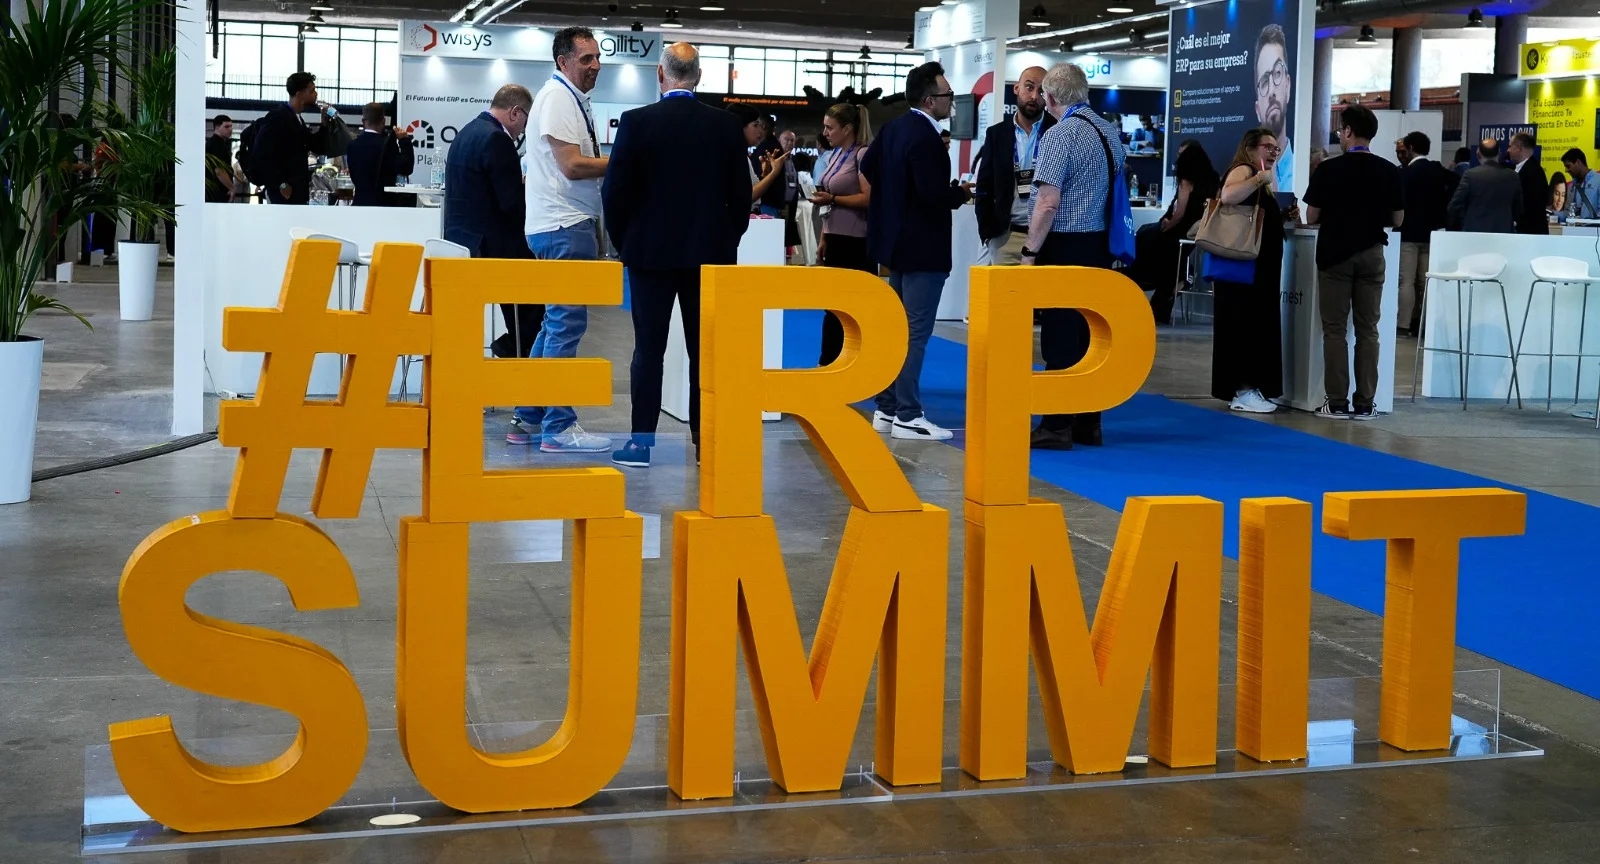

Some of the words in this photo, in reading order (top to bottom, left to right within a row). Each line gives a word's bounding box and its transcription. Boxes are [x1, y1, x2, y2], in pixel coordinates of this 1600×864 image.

[441, 32, 492, 51] wisys
[600, 34, 655, 58] gility
[1175, 34, 1194, 54] ¿Cuál
[1195, 37, 1202, 48] es
[1203, 32, 1209, 47] el
[1210, 30, 1231, 49] mejor
[1175, 58, 1189, 73] ERP
[1189, 60, 1205, 76] para
[1205, 58, 1214, 70] su
[1214, 50, 1249, 72] empresa?
[1565, 108, 1573, 117] Te
[1556, 119, 1564, 128] En
[1481, 127, 1506, 141] IONOS
[1280, 290, 1303, 305] nest
[108, 487, 1527, 834] SUMMIT
